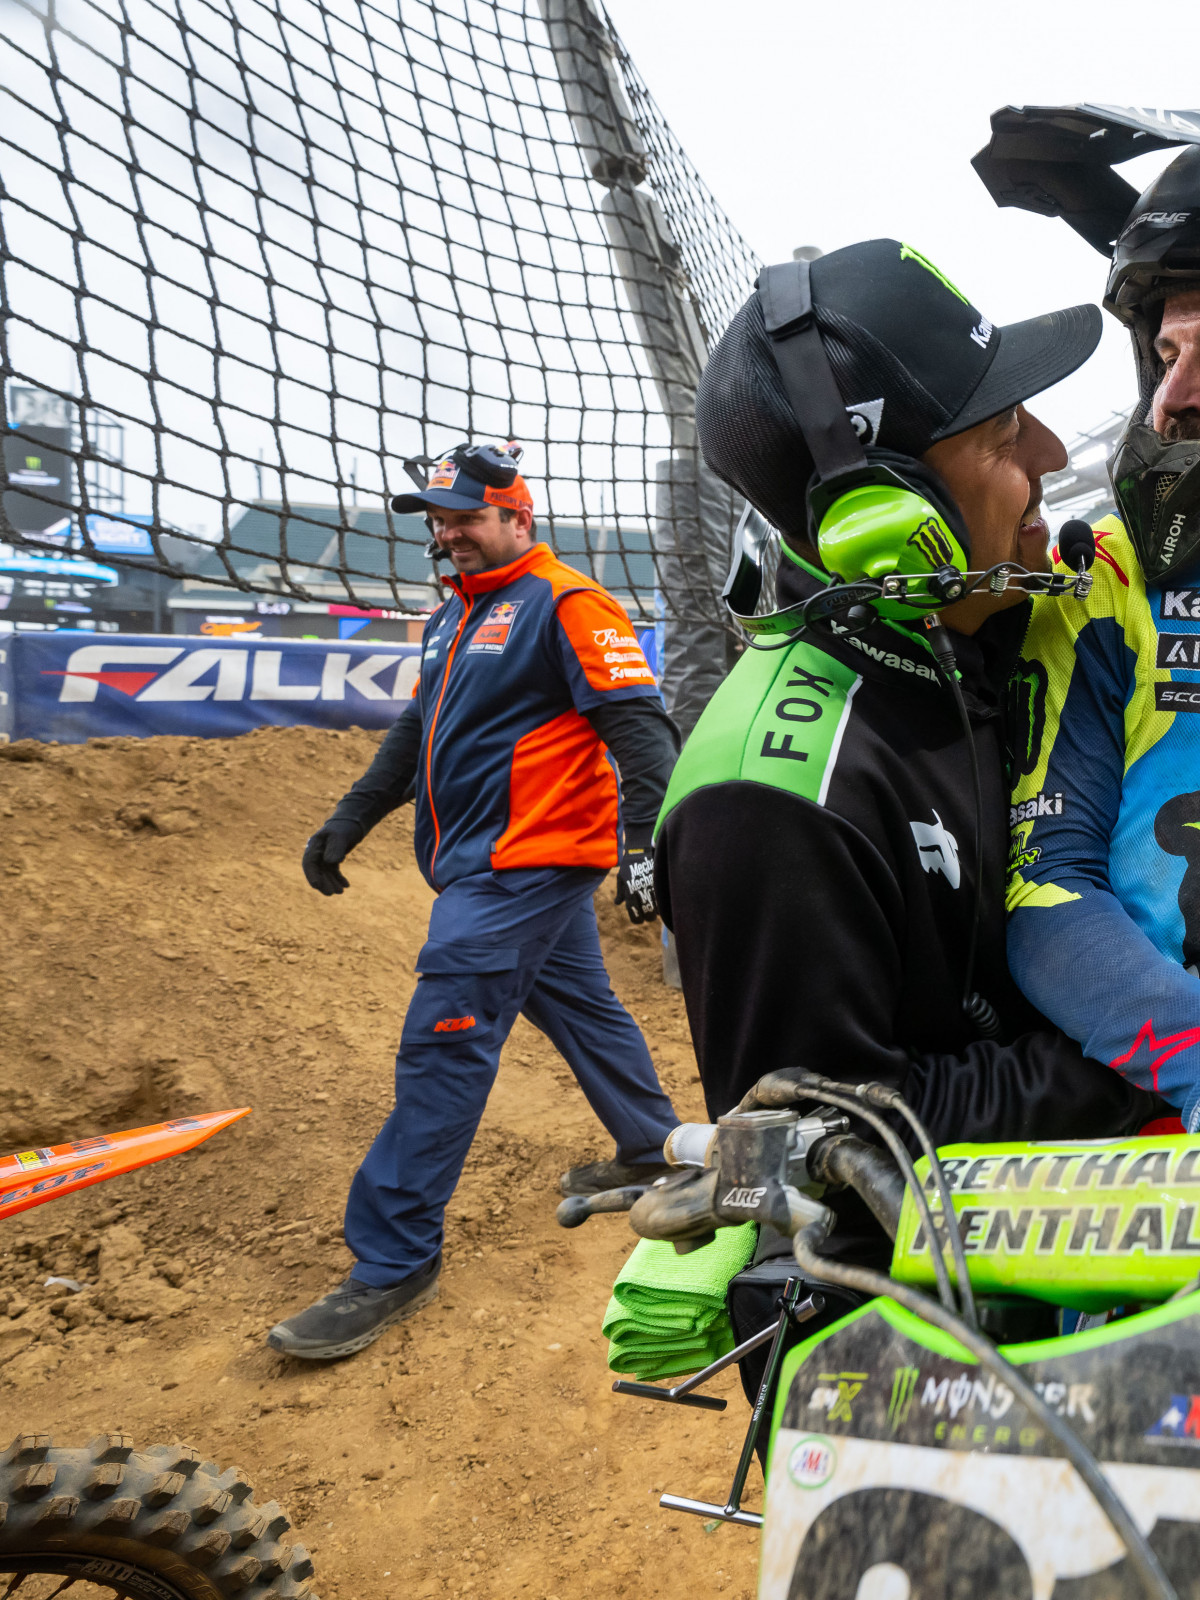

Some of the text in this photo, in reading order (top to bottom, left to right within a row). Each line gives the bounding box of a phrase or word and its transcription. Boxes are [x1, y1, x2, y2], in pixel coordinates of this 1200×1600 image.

[1160, 513, 1187, 566] AIROH
[829, 619, 942, 688] Kawasak
[759, 665, 834, 763] FOX
[434, 1015, 476, 1032] KTM
[721, 1187, 767, 1208] ARC
[920, 1372, 1097, 1423] MONSER
[935, 1421, 1040, 1447] ENERG
